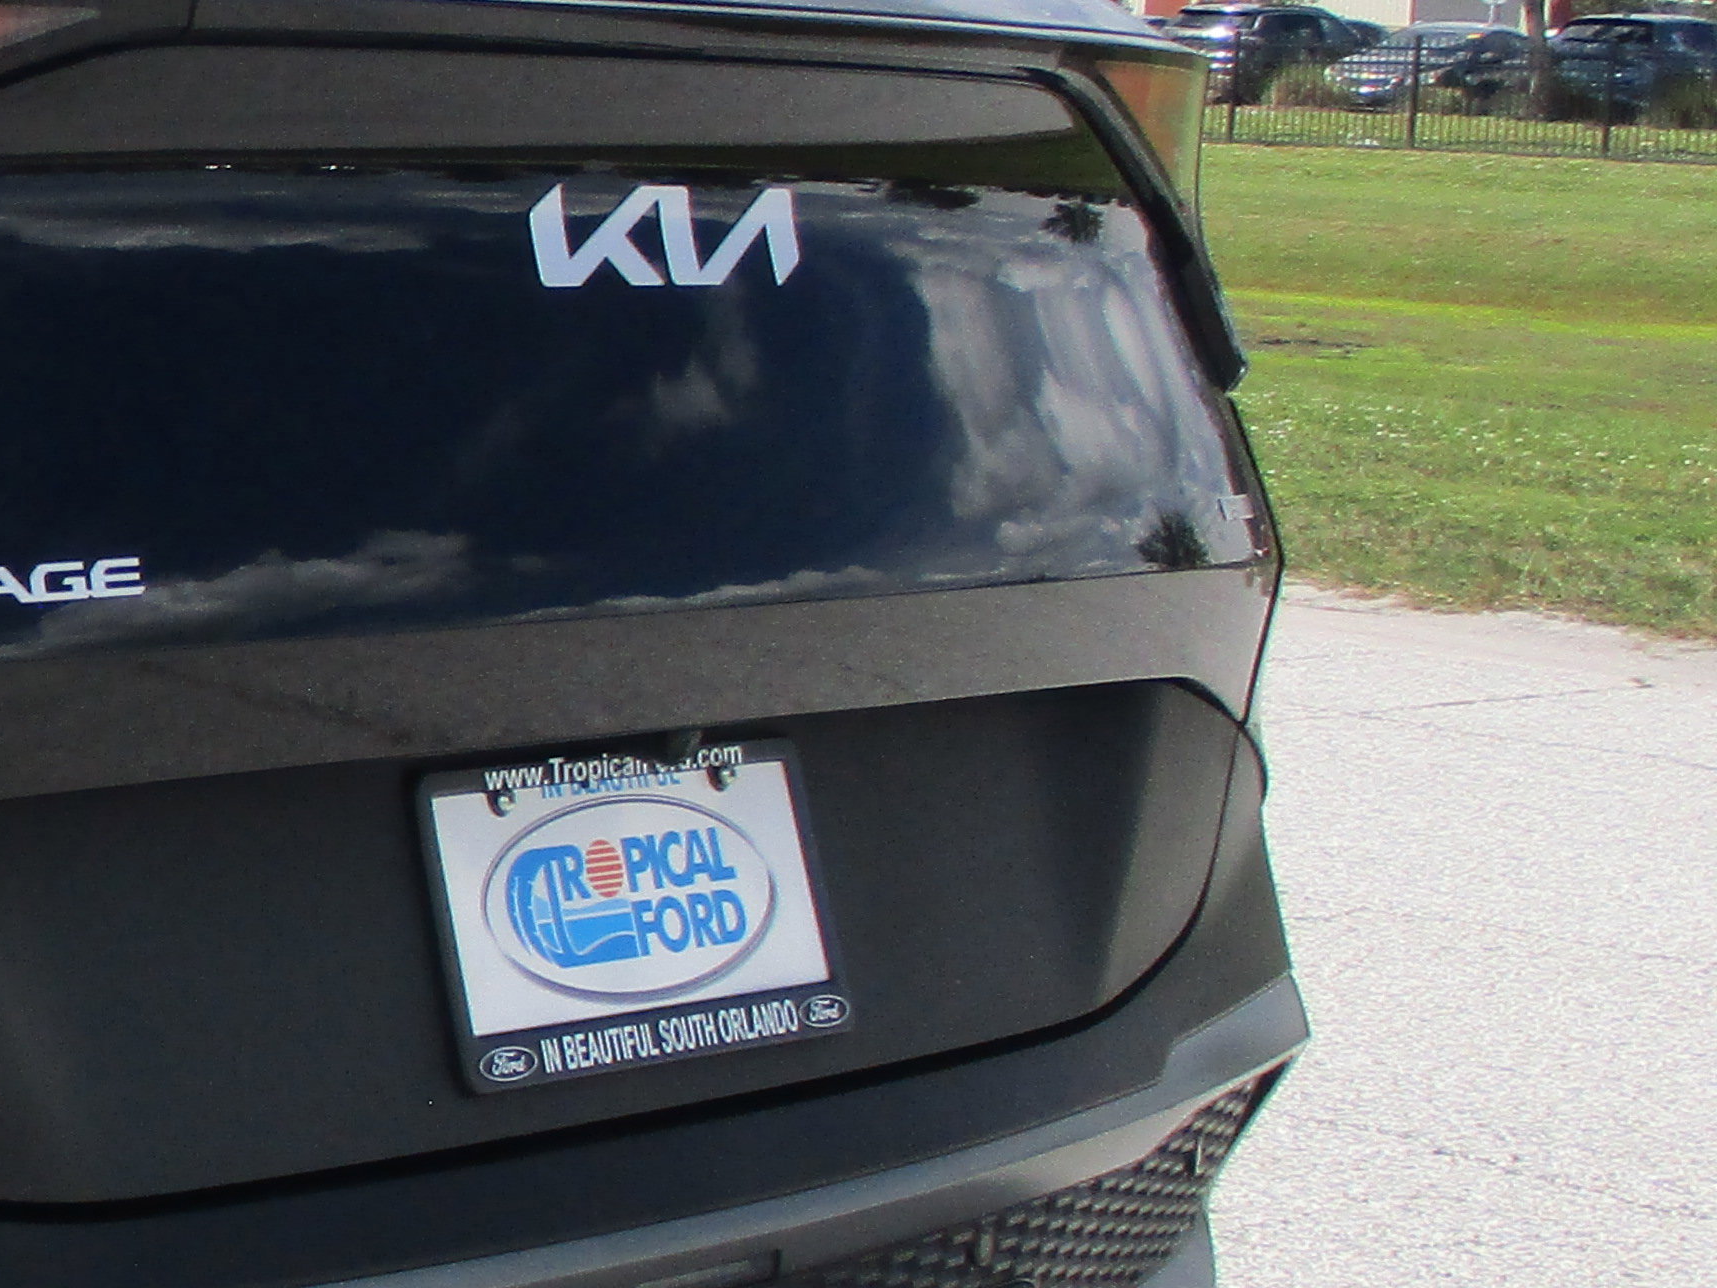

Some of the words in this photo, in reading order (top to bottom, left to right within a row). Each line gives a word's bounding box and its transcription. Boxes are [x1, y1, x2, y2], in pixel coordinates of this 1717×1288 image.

[529, 182, 800, 288] KIA
[484, 744, 743, 791] www.Tropical.com
[515, 826, 737, 902] TROPICAL
[630, 888, 748, 957] FORD
[540, 1039, 561, 1074] IN
[563, 1023, 662, 1070] BEAUTIFUL
[657, 1011, 720, 1056] SOUTH
[719, 998, 800, 1047] ORLANDO
